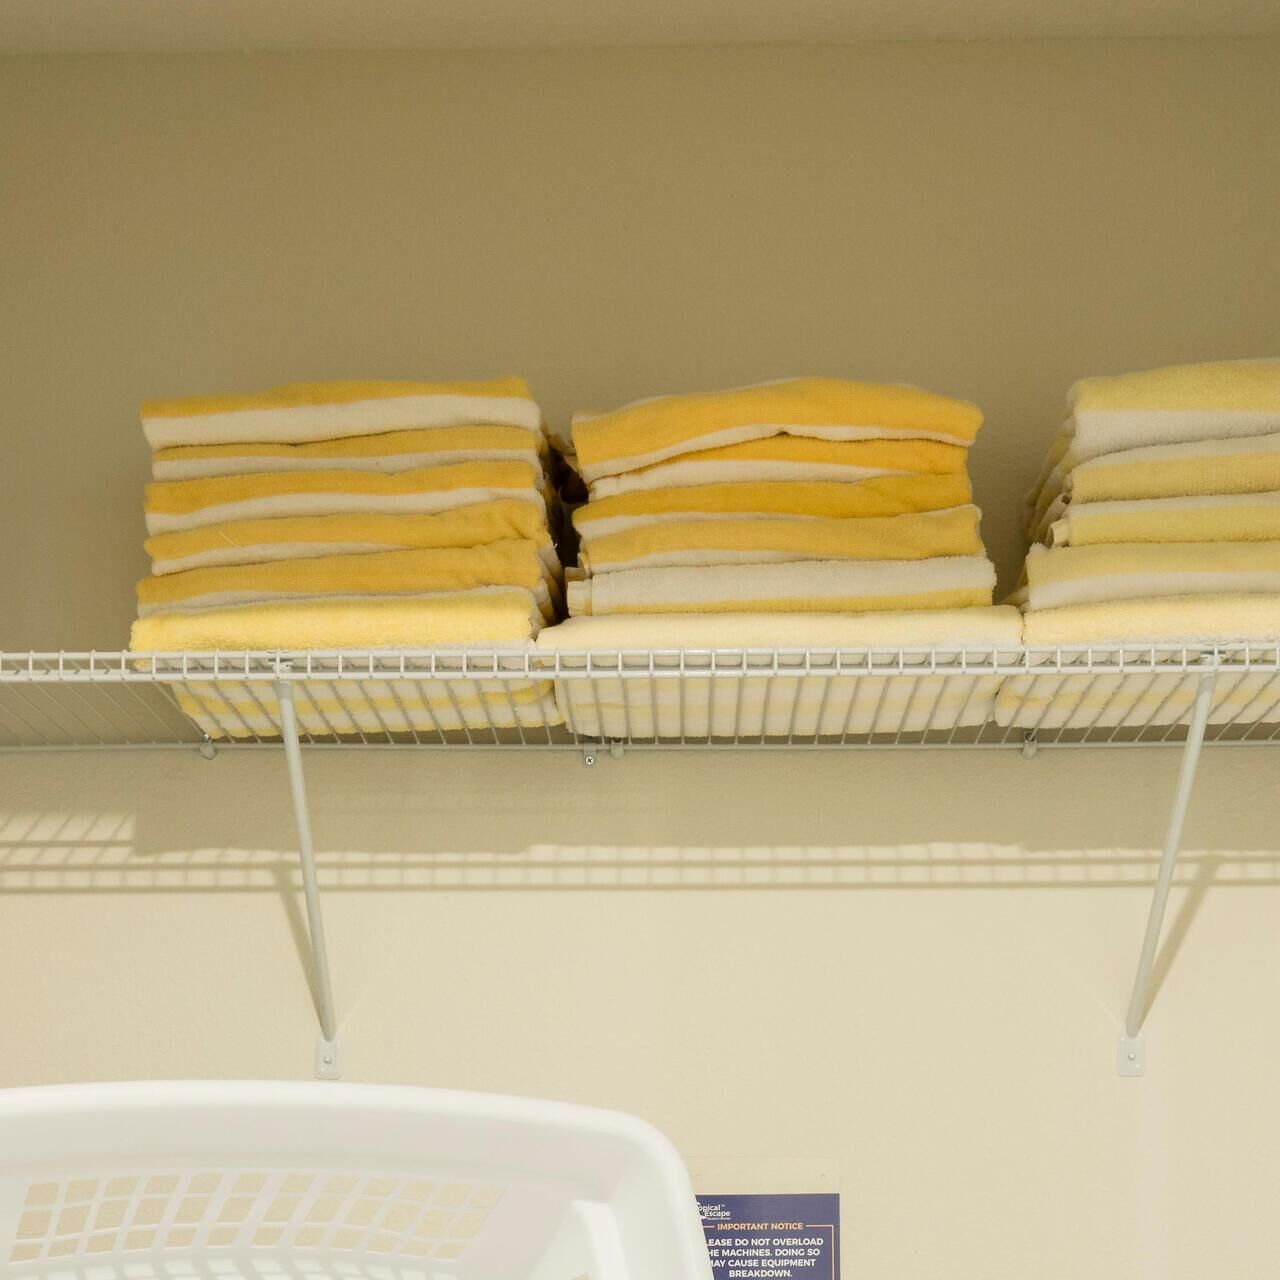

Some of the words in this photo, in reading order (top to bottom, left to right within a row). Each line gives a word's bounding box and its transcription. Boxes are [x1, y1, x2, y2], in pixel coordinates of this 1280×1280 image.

[697, 1202, 720, 1212] opical
[772, 1238, 824, 1246] OVERLOAD
[728, 1259, 759, 1267] CAUSE
[761, 1258, 816, 1268] EQUIPMENT
[729, 1270, 792, 1278] BREAKDOWN.
